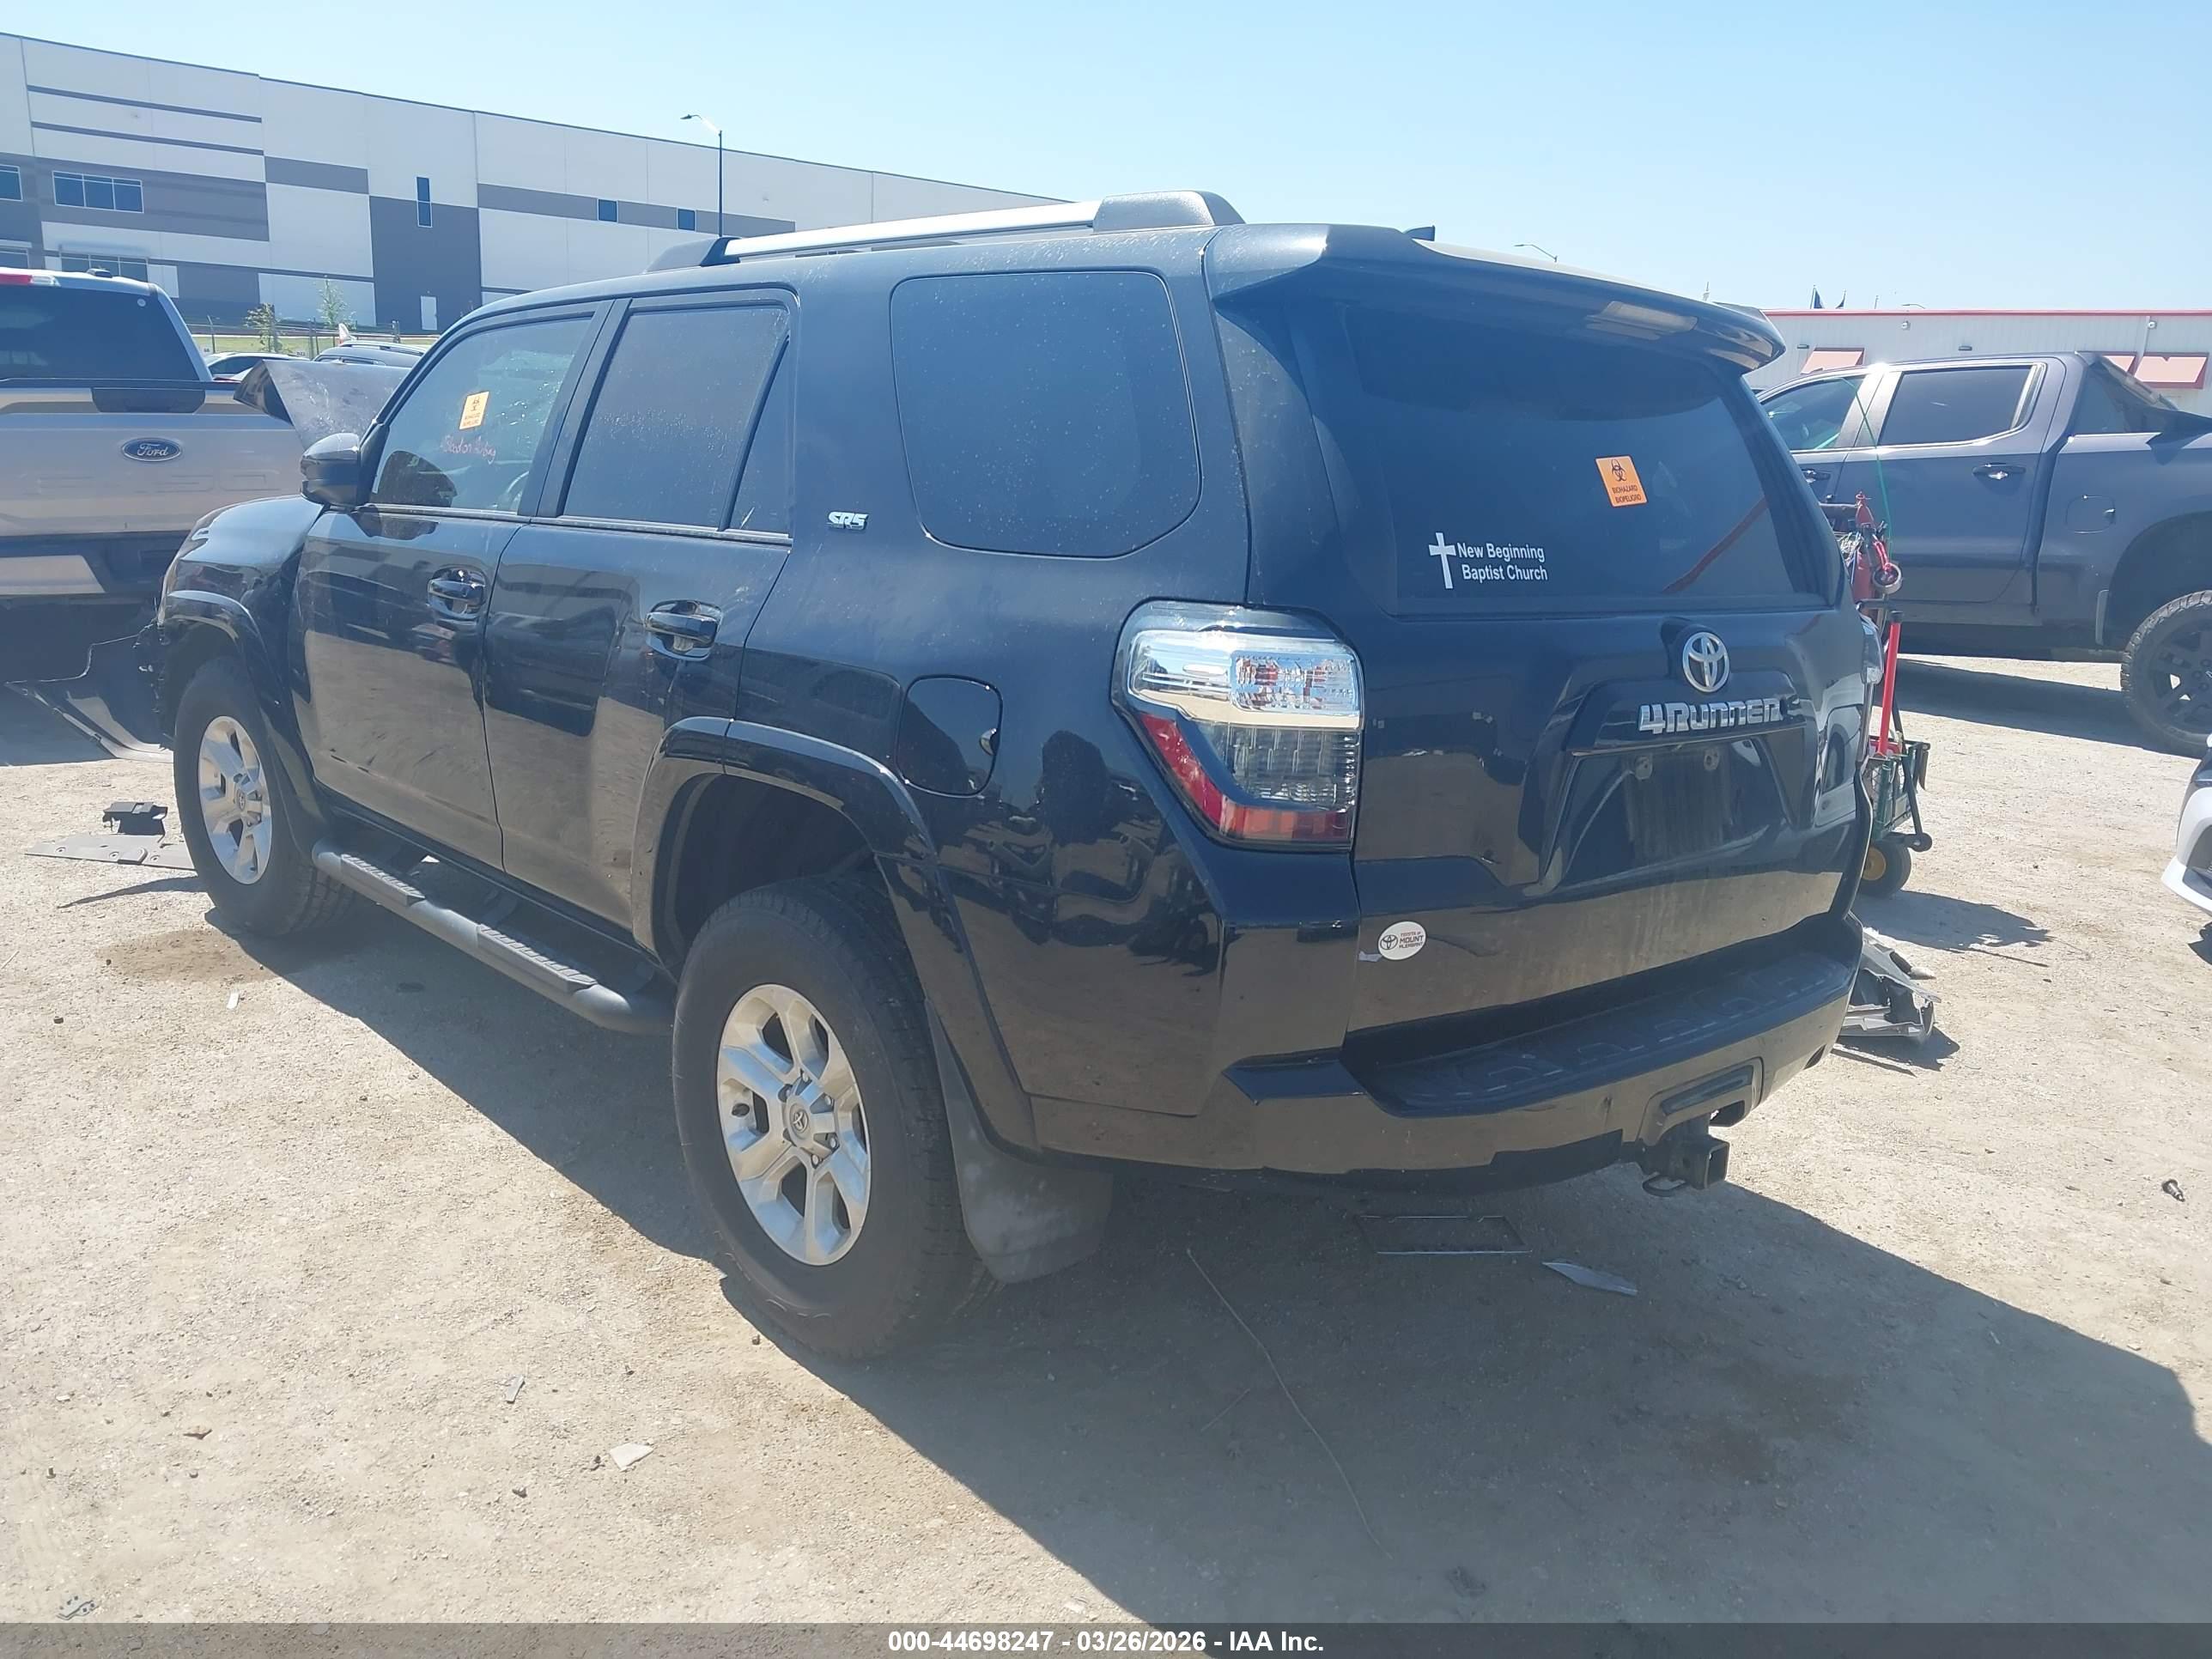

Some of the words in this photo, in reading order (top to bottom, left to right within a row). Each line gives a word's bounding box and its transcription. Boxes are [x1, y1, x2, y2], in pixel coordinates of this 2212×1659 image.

[137, 443, 168, 456] Ford
[828, 512, 869, 530] SR5
[1457, 542, 1484, 558] New
[1486, 543, 1545, 562] Beginning
[1462, 564, 1504, 583] Baptist
[1506, 564, 1548, 580] Church
[1399, 935, 1424, 944] MOUNT
